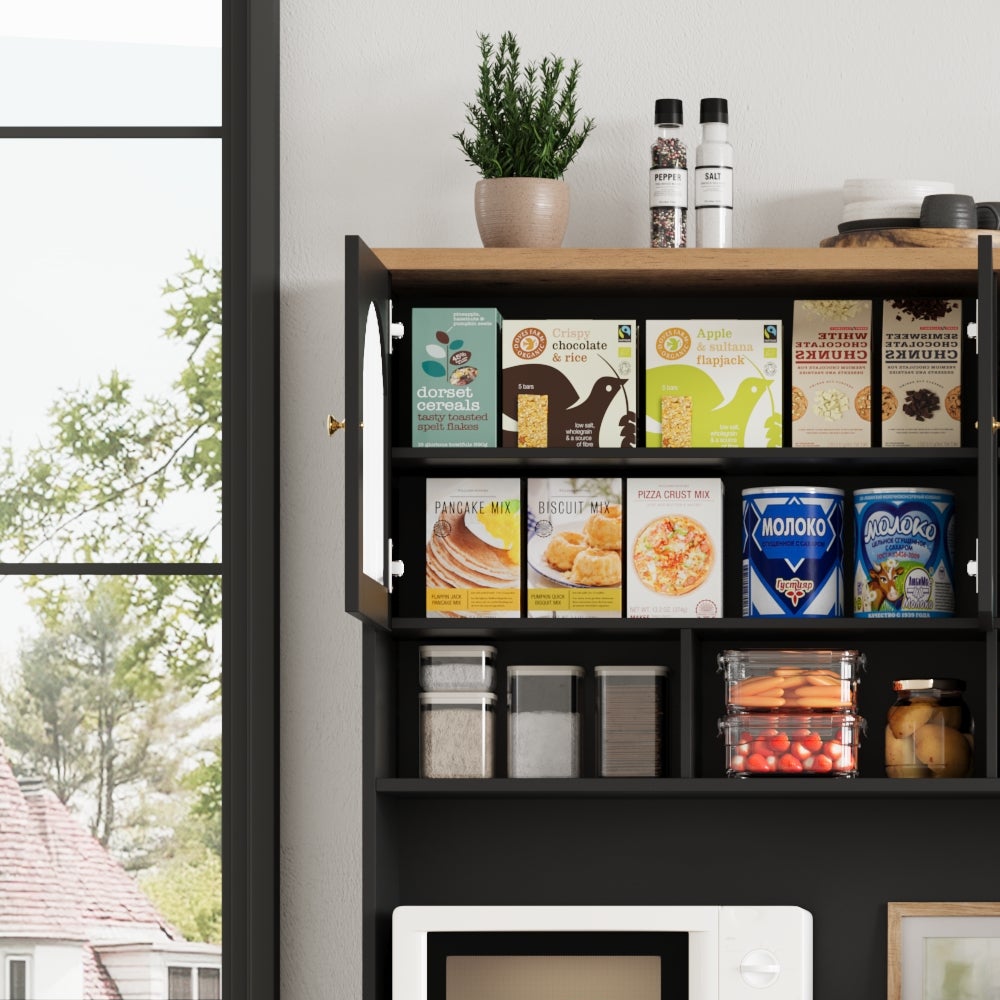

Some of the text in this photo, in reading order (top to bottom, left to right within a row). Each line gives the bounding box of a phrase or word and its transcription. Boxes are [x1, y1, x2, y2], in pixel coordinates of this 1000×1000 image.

[654, 173, 682, 181] PEPPER
[704, 172, 721, 180] SALT
[552, 328, 591, 340] Crispy
[696, 328, 733, 340] Apple
[517, 344, 545, 359] ORGANIC
[552, 340, 608, 351] chocolate
[696, 342, 754, 352] & sultana
[552, 353, 588, 362] & rice
[696, 355, 745, 367] flapjack
[416, 386, 474, 398] dorset
[416, 399, 481, 411] cereals
[417, 413, 488, 422] tasty toasted
[417, 422, 479, 432] spelt flakes
[637, 490, 710, 499] PIZZA CRUST MIX
[434, 501, 511, 514] PANCAKE MIX
[538, 501, 610, 514] BISCUIT MIX
[761, 517, 827, 537] МОЛОКО
